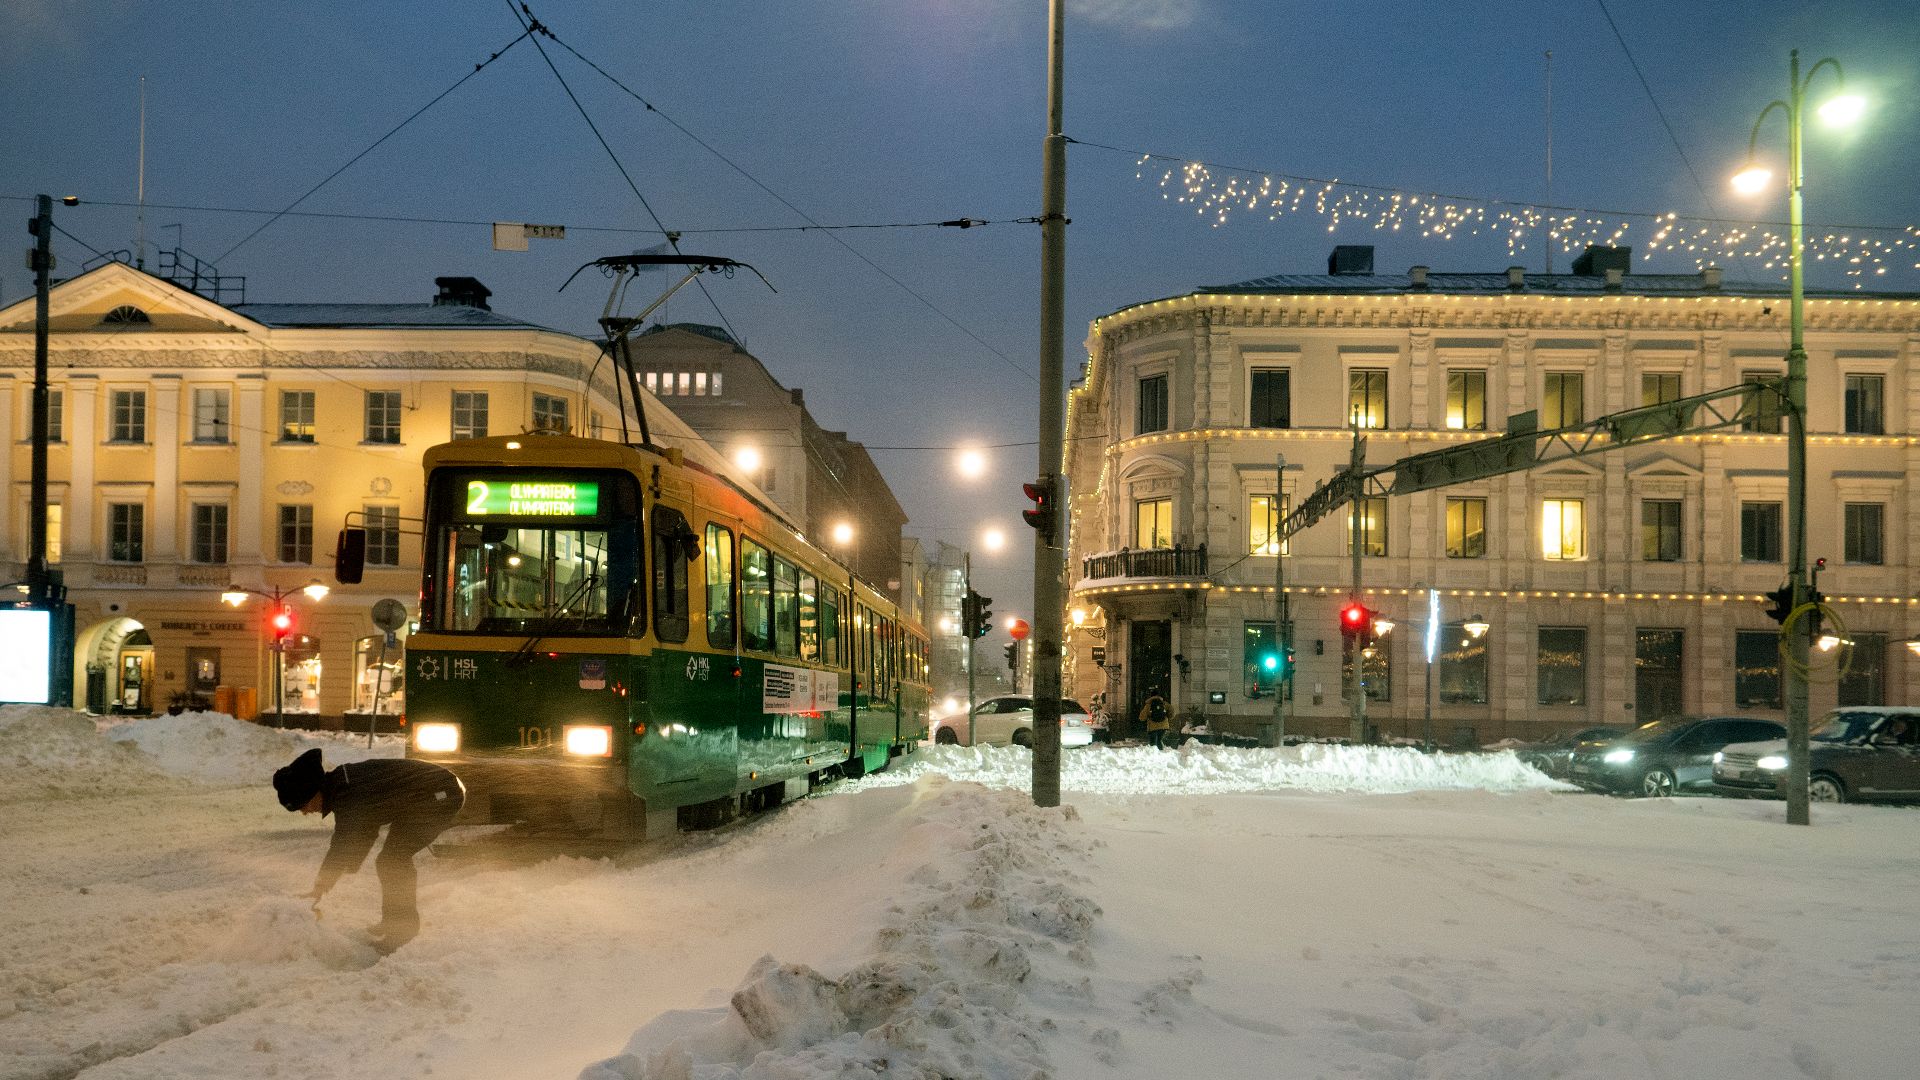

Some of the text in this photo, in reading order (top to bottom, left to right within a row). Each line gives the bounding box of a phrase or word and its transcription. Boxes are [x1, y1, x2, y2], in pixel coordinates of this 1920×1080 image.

[466, 481, 489, 514] 2
[454, 658, 478, 669] HSL
[698, 657, 710, 669] HKL
[454, 669, 478, 679] HRT
[698, 669, 710, 680] HST
[519, 726, 551, 748] 101
